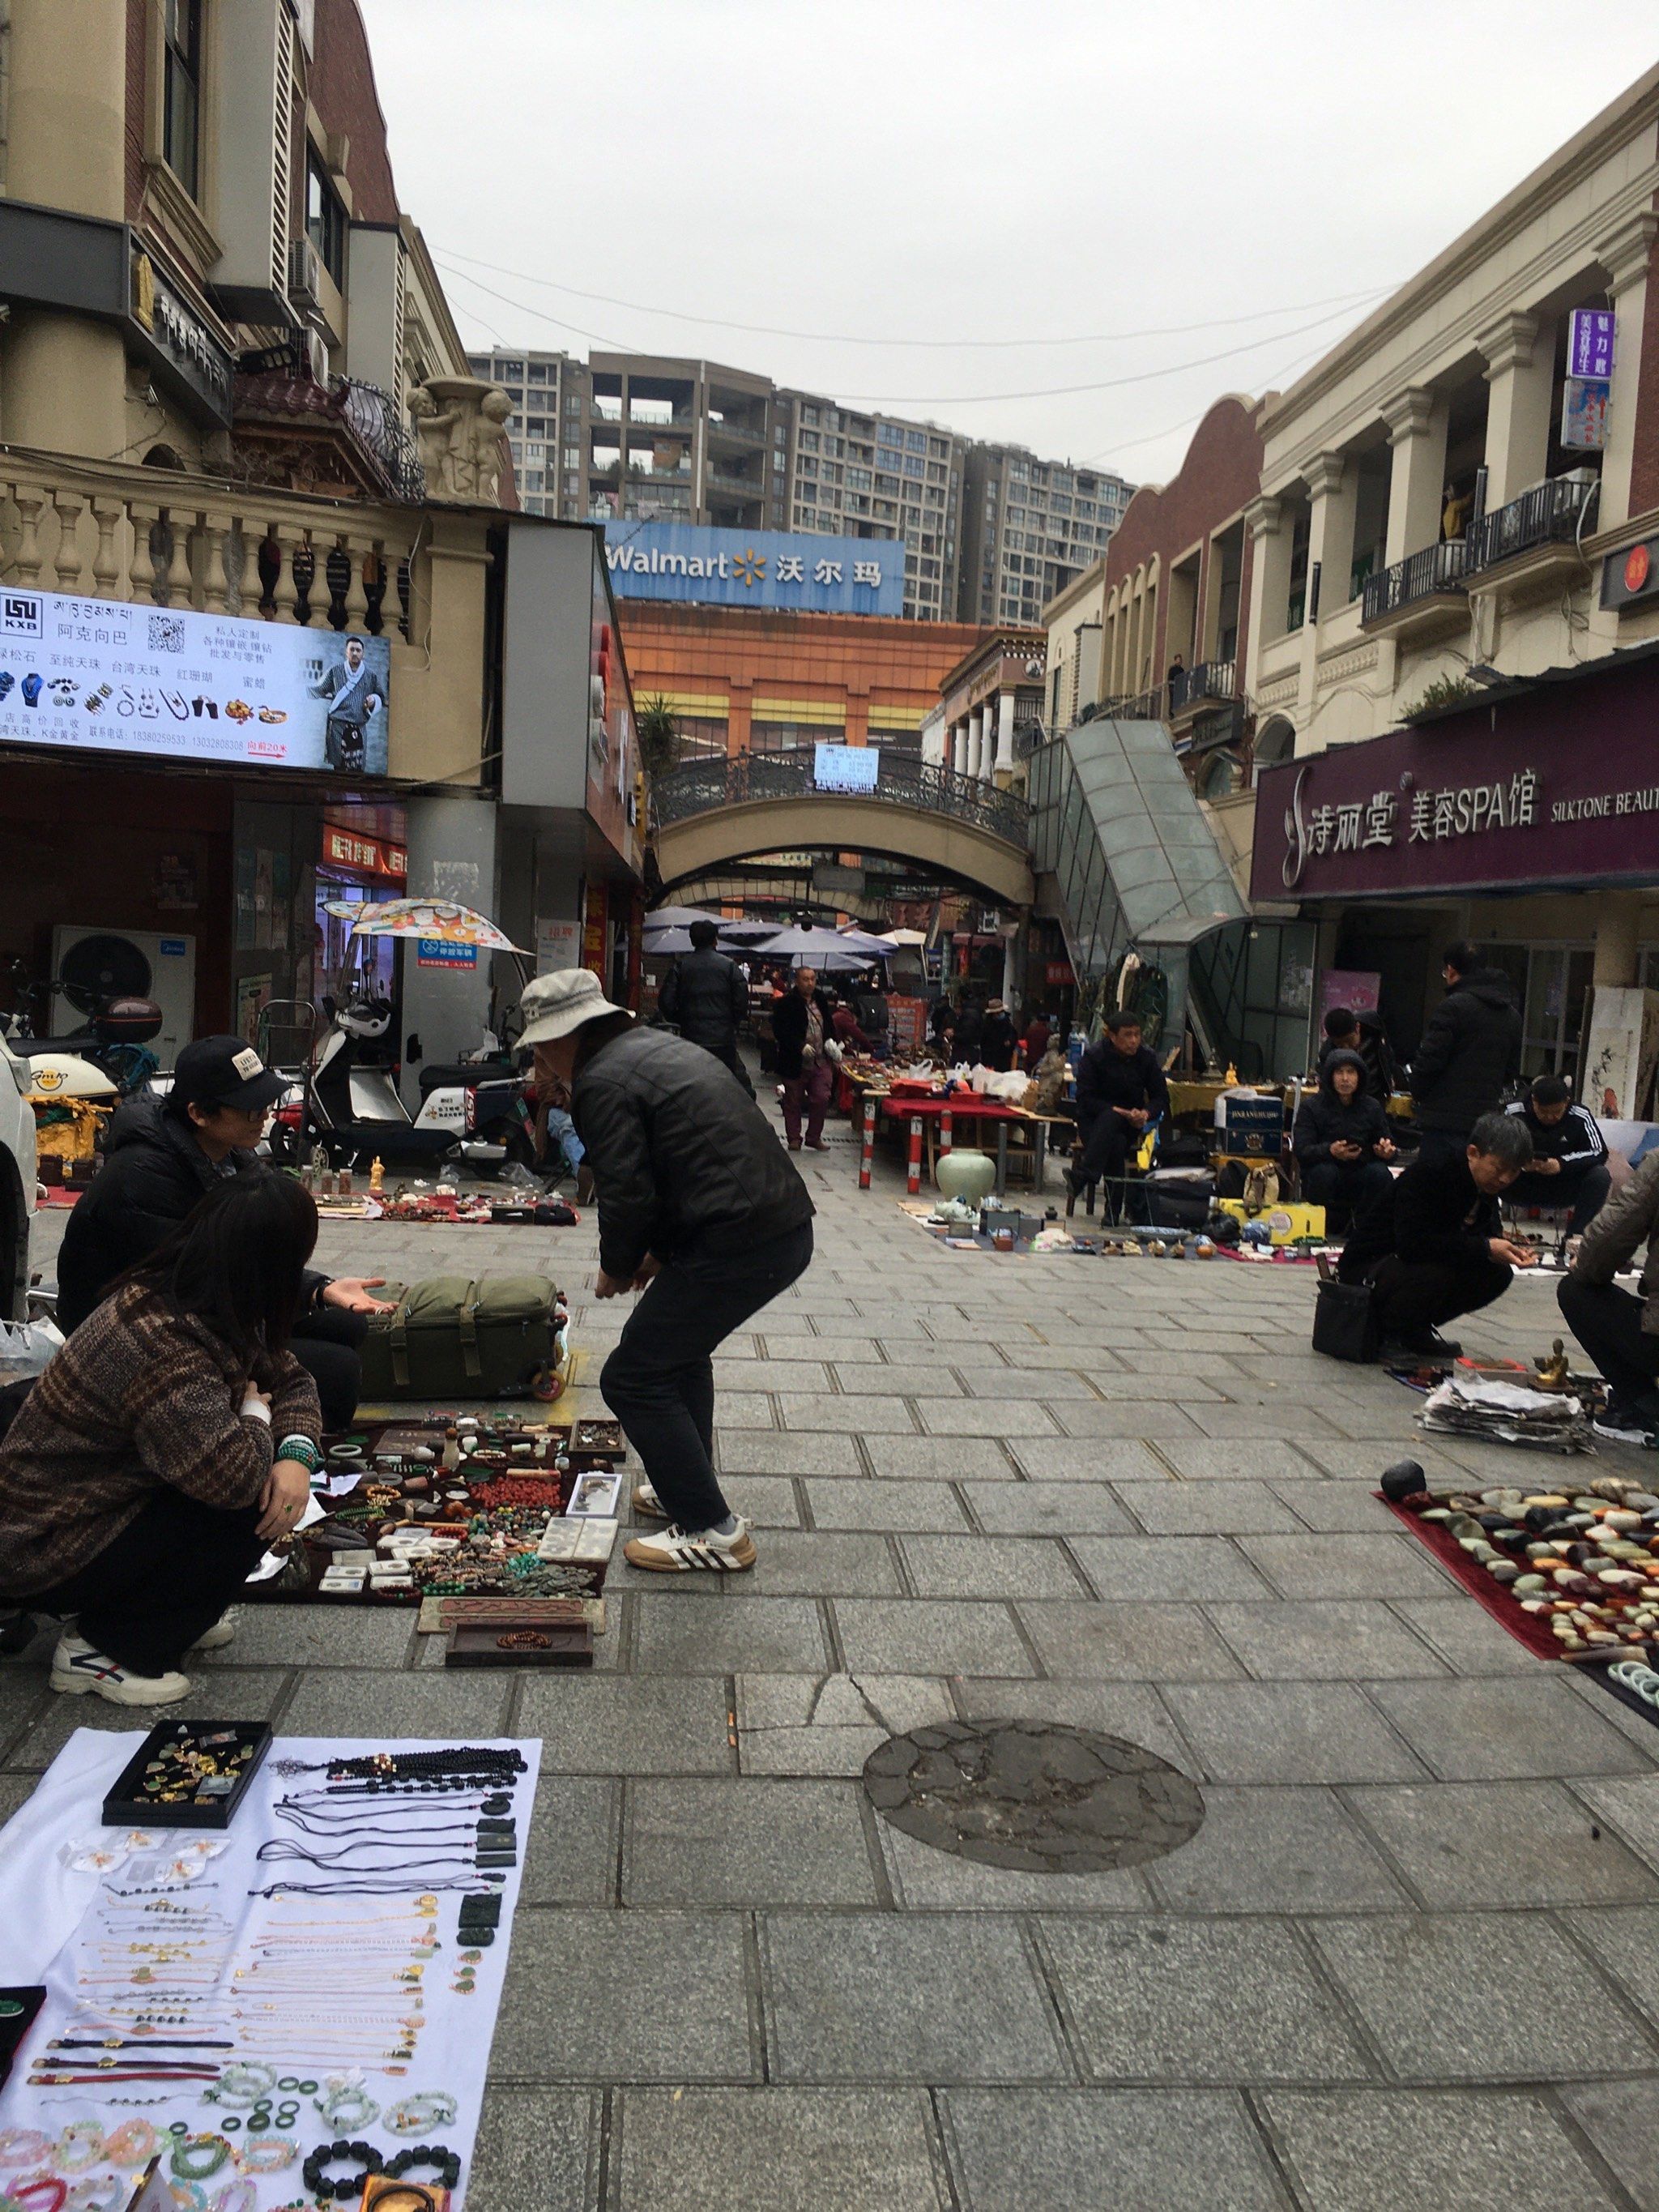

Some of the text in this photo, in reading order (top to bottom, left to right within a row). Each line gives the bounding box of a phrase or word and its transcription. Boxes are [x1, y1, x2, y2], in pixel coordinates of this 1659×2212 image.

[604, 544, 728, 579] Walmart
[776, 554, 881, 587] 沃尔玛
[5, 619, 37, 630] KXB
[58, 623, 127, 645] 阿克向巴
[49, 654, 101, 671] 至纯天珠
[112, 660, 162, 677] 台湾天珠
[177, 669, 213, 683] 红珊瑚
[247, 741, 287, 753] 向前20米
[1307, 768, 1537, 855] 诗丽堂 美容SPA馆
[1551, 795, 1611, 822] SILKTONE
